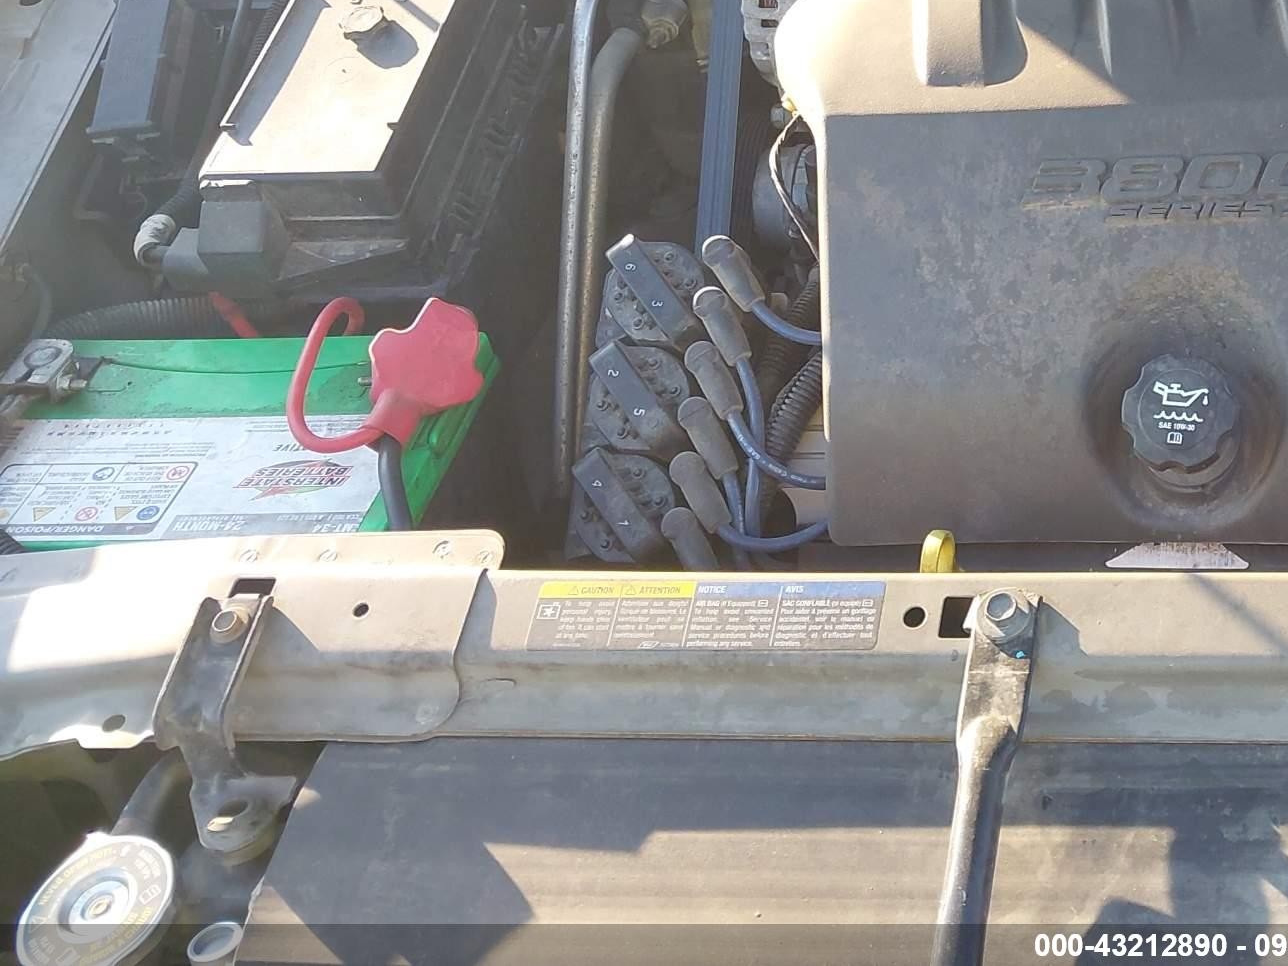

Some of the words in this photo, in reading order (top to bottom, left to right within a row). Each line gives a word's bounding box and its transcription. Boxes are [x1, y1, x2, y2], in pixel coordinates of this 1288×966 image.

[1105, 200, 1272, 222] SERIES
[255, 467, 349, 477] BATTERIES
[242, 477, 346, 486] INTERSTATE
[6, 525, 104, 533] DANGER/POISON
[172, 520, 245, 532] 24-MONTH
[581, 586, 614, 594] CAUTION
[639, 586, 681, 594] ATTENTION
[698, 585, 728, 594] NOTICE
[785, 585, 804, 593] AVIS
